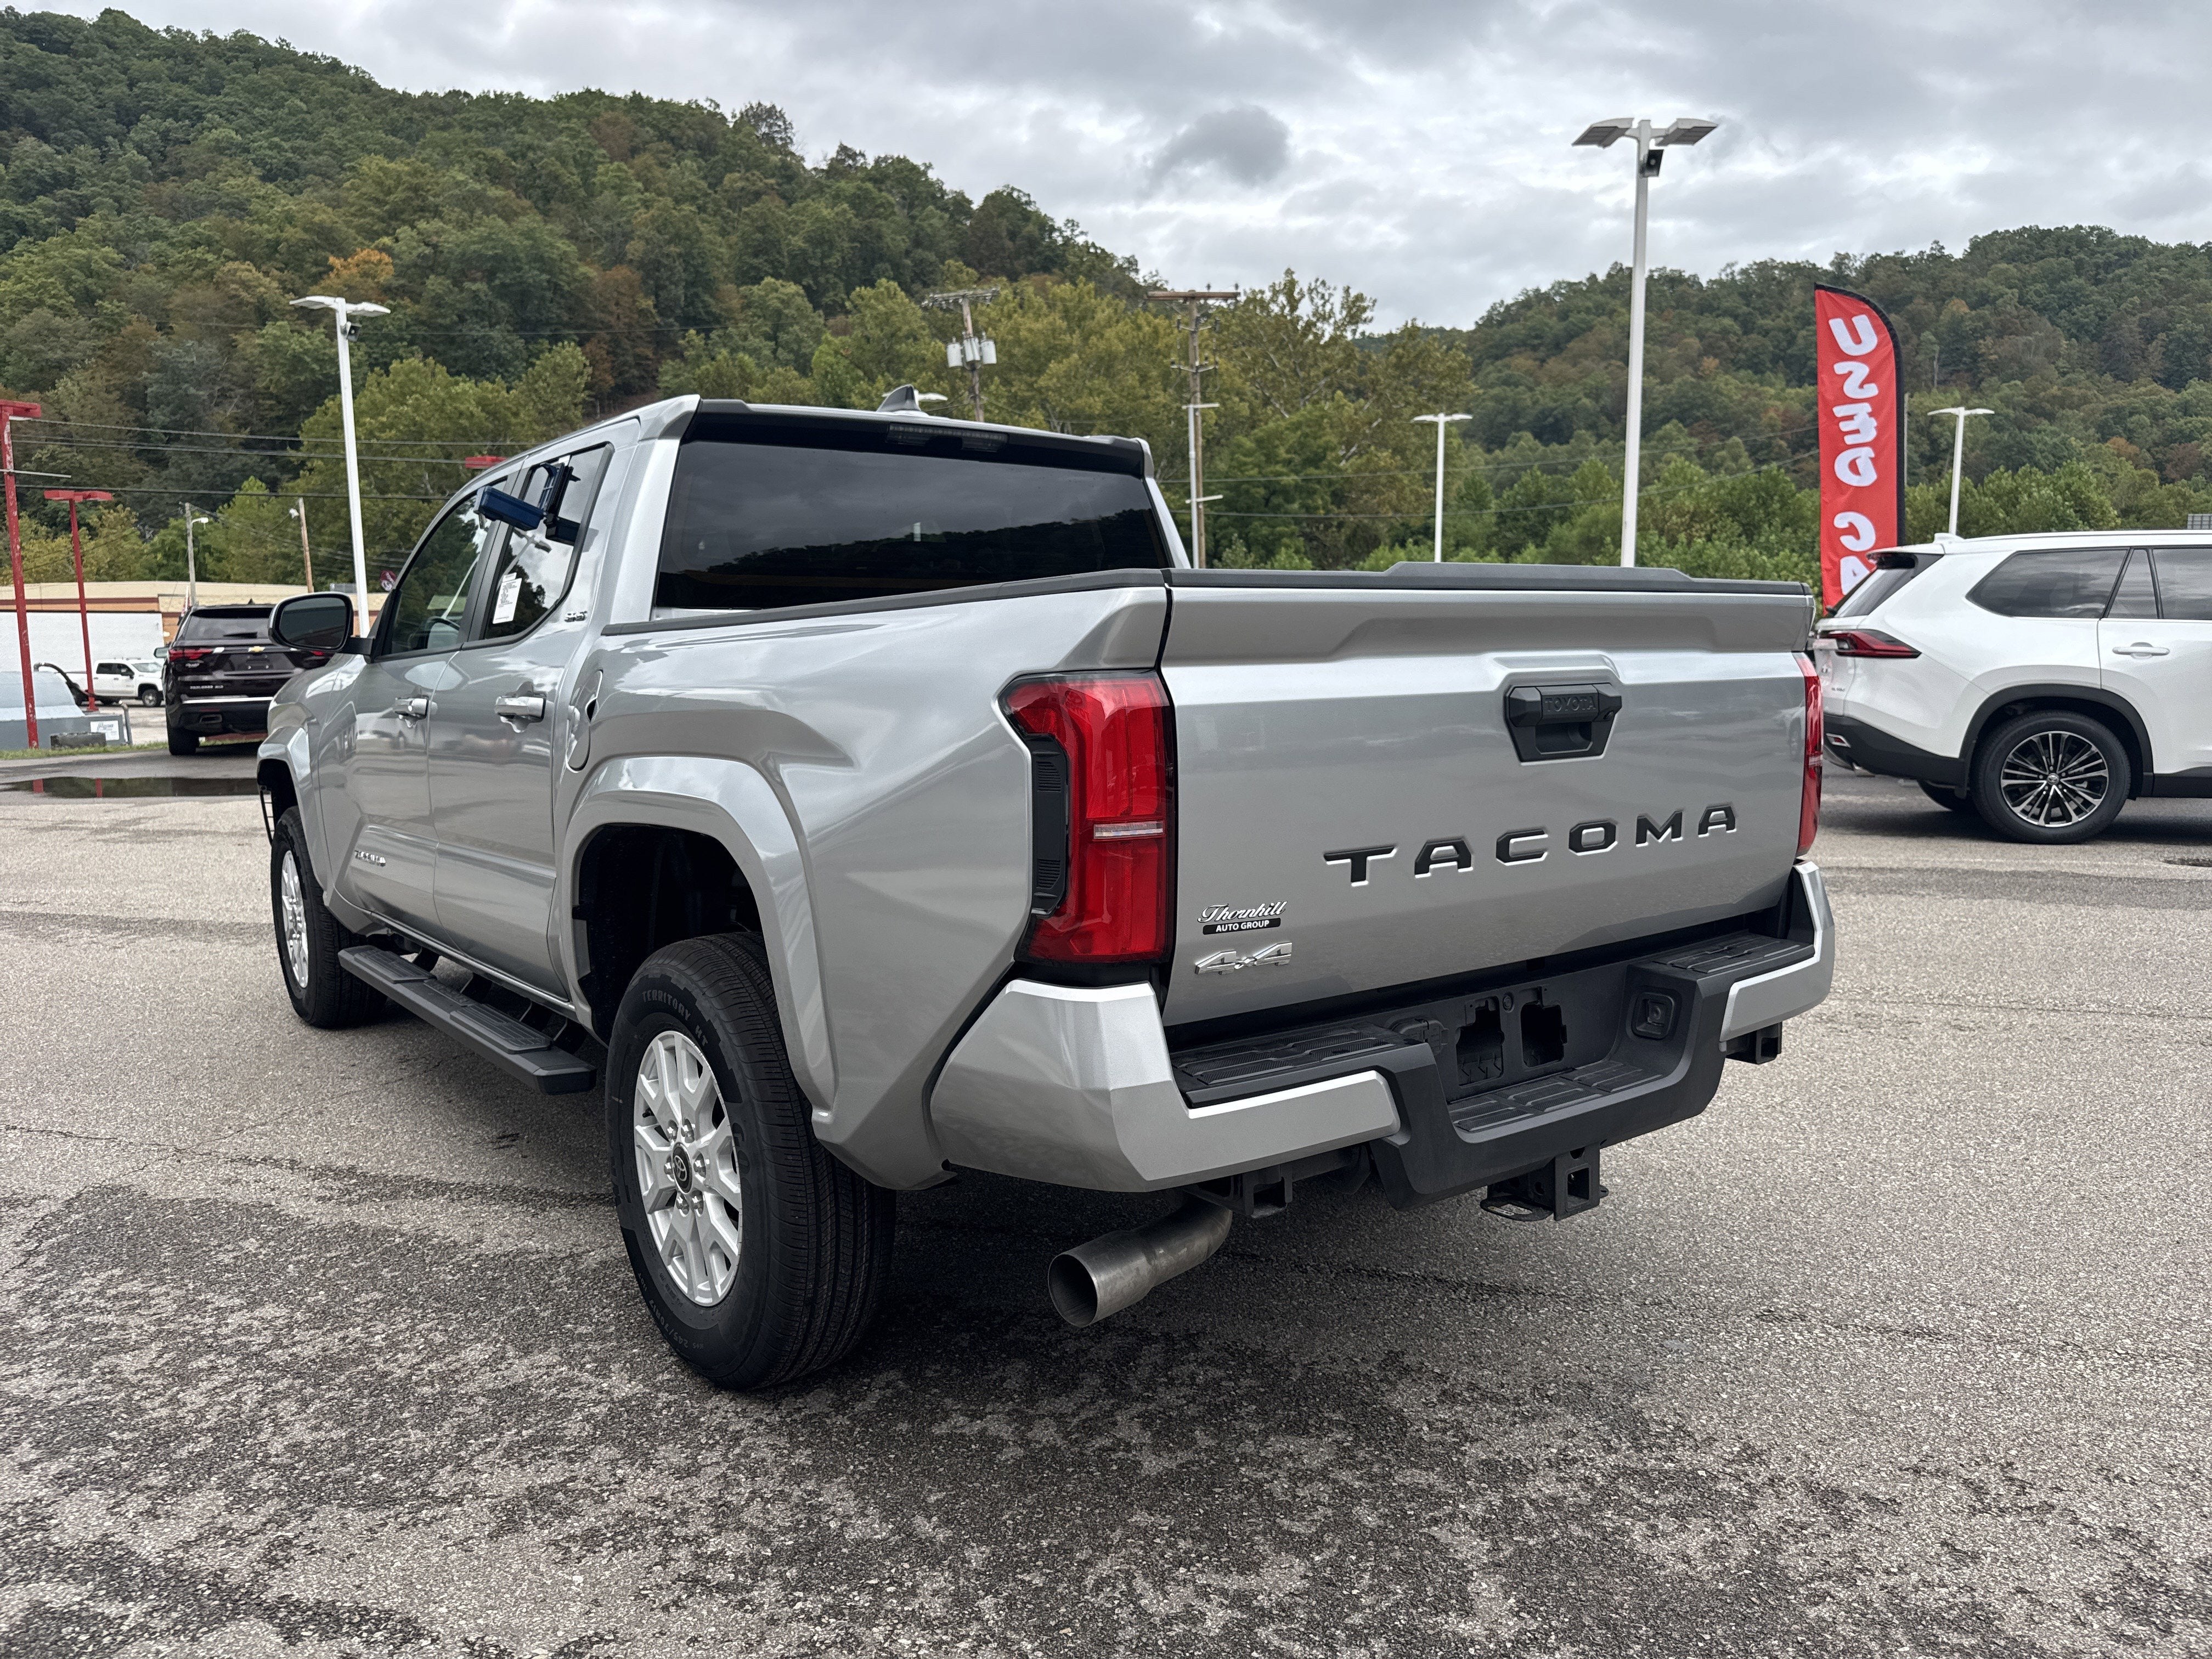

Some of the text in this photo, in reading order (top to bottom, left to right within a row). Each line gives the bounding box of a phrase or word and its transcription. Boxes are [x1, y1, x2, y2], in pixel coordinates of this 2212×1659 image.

[1544, 695, 1596, 713] TOYOTA
[1323, 803, 1738, 887] TACOMA
[1197, 900, 1288, 923] Thornhill
[1215, 919, 1269, 933] AUTO GROUP
[641, 989, 691, 1022] TERRITORY
